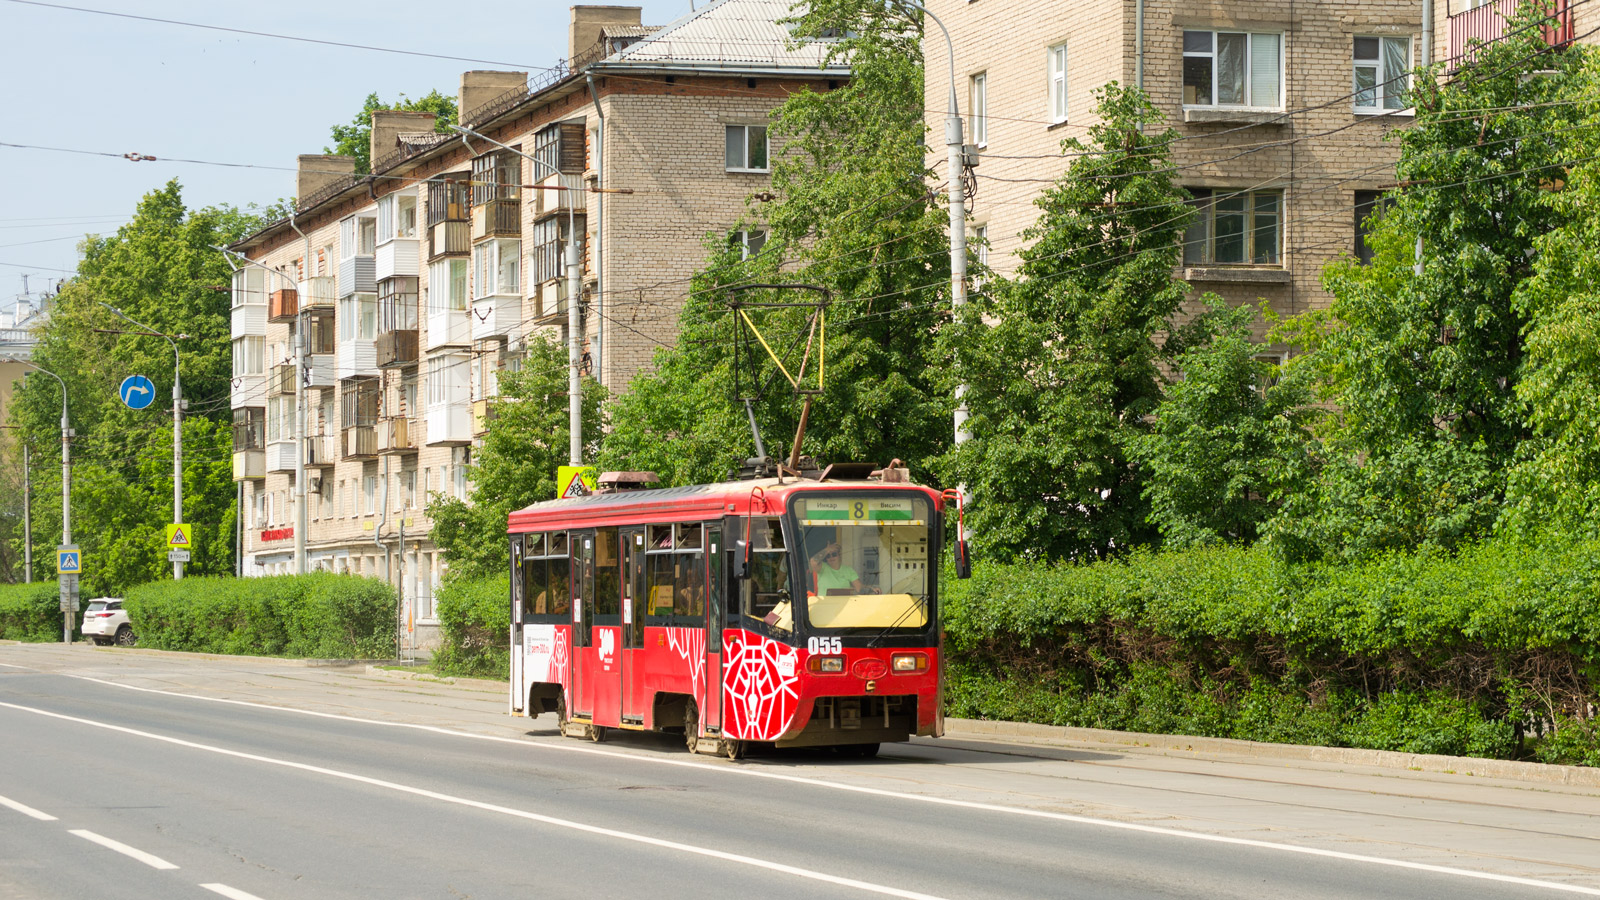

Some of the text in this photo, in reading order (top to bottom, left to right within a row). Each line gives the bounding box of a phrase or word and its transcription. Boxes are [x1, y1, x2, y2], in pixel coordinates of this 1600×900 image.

[816, 502, 838, 510] Инкар
[854, 501, 864, 519] 8
[807, 636, 842, 655] 055
